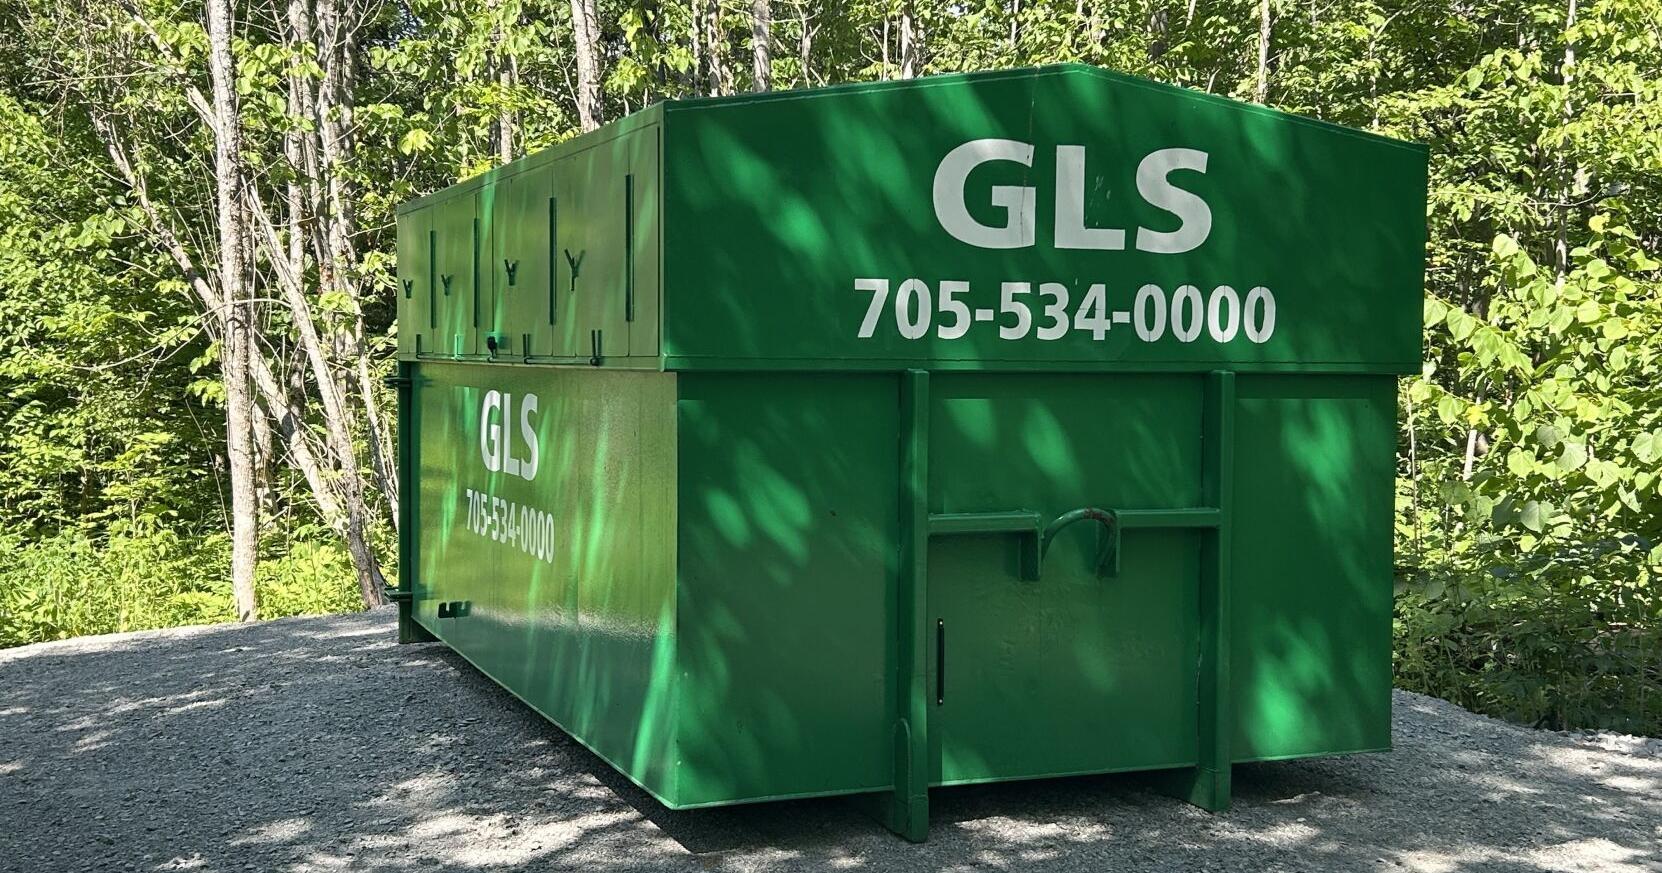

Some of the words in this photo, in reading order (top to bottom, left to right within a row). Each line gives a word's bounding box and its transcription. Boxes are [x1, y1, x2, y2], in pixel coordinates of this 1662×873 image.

[933, 139, 1211, 253] GLS
[855, 279, 1275, 343] 705-534-0000
[482, 390, 539, 480] GLS
[466, 489, 554, 563] 705-534-0000
